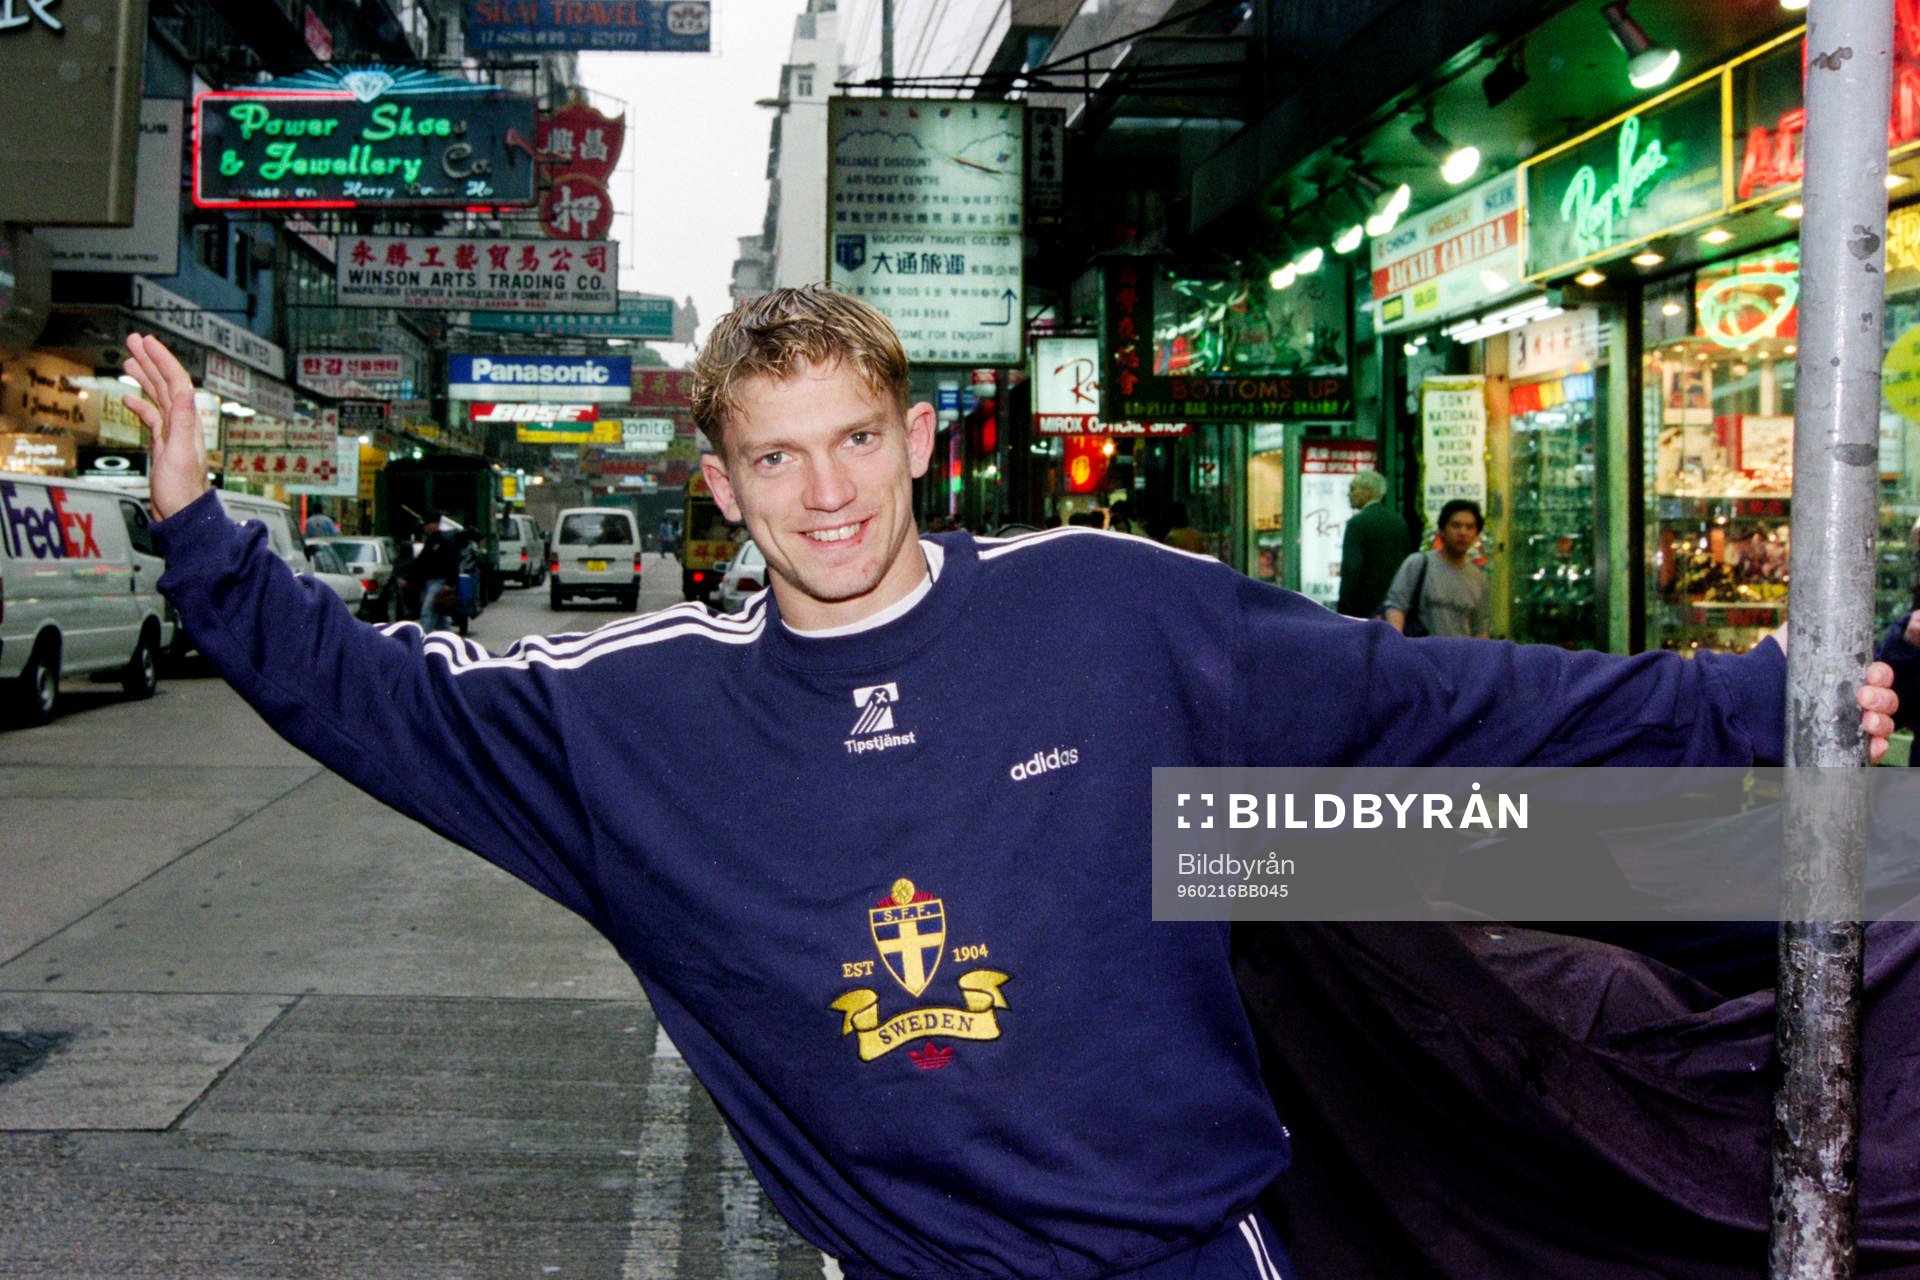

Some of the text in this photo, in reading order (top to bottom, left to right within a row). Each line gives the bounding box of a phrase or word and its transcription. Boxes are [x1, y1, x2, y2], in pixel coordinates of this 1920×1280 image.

[552, 1, 644, 28] TRAVEL
[228, 103, 338, 140] Power
[220, 149, 244, 176] &
[259, 142, 423, 182] Jewellery
[871, 234, 924, 245] VACATION
[931, 235, 966, 246] TRAVEL
[1443, 218, 1513, 273] CAMERA
[348, 268, 607, 291] WINSON ARTS TRADING CO.
[472, 357, 610, 385] Panasonic
[1172, 379, 1339, 400] BOTTOMS UP
[1440, 394, 1471, 407] SONY
[490, 404, 593, 422] BOSE
[1428, 409, 1480, 421] NATIONAL
[1040, 416, 1084, 432] MIROX
[1433, 424, 1477, 437] MINOLTA
[1438, 440, 1472, 451] NIKON
[1437, 454, 1473, 467] CANON
[1444, 468, 1469, 481] JVC
[1428, 483, 1480, 496] NINTENDO
[1, 480, 102, 559] FedEx
[844, 731, 916, 754] Tipstjänst
[1010, 746, 1079, 781] adidas
[884, 905, 932, 922] S.F.F.
[842, 944, 989, 978] EST 1904
[878, 1013, 975, 1046] SWEDEN
